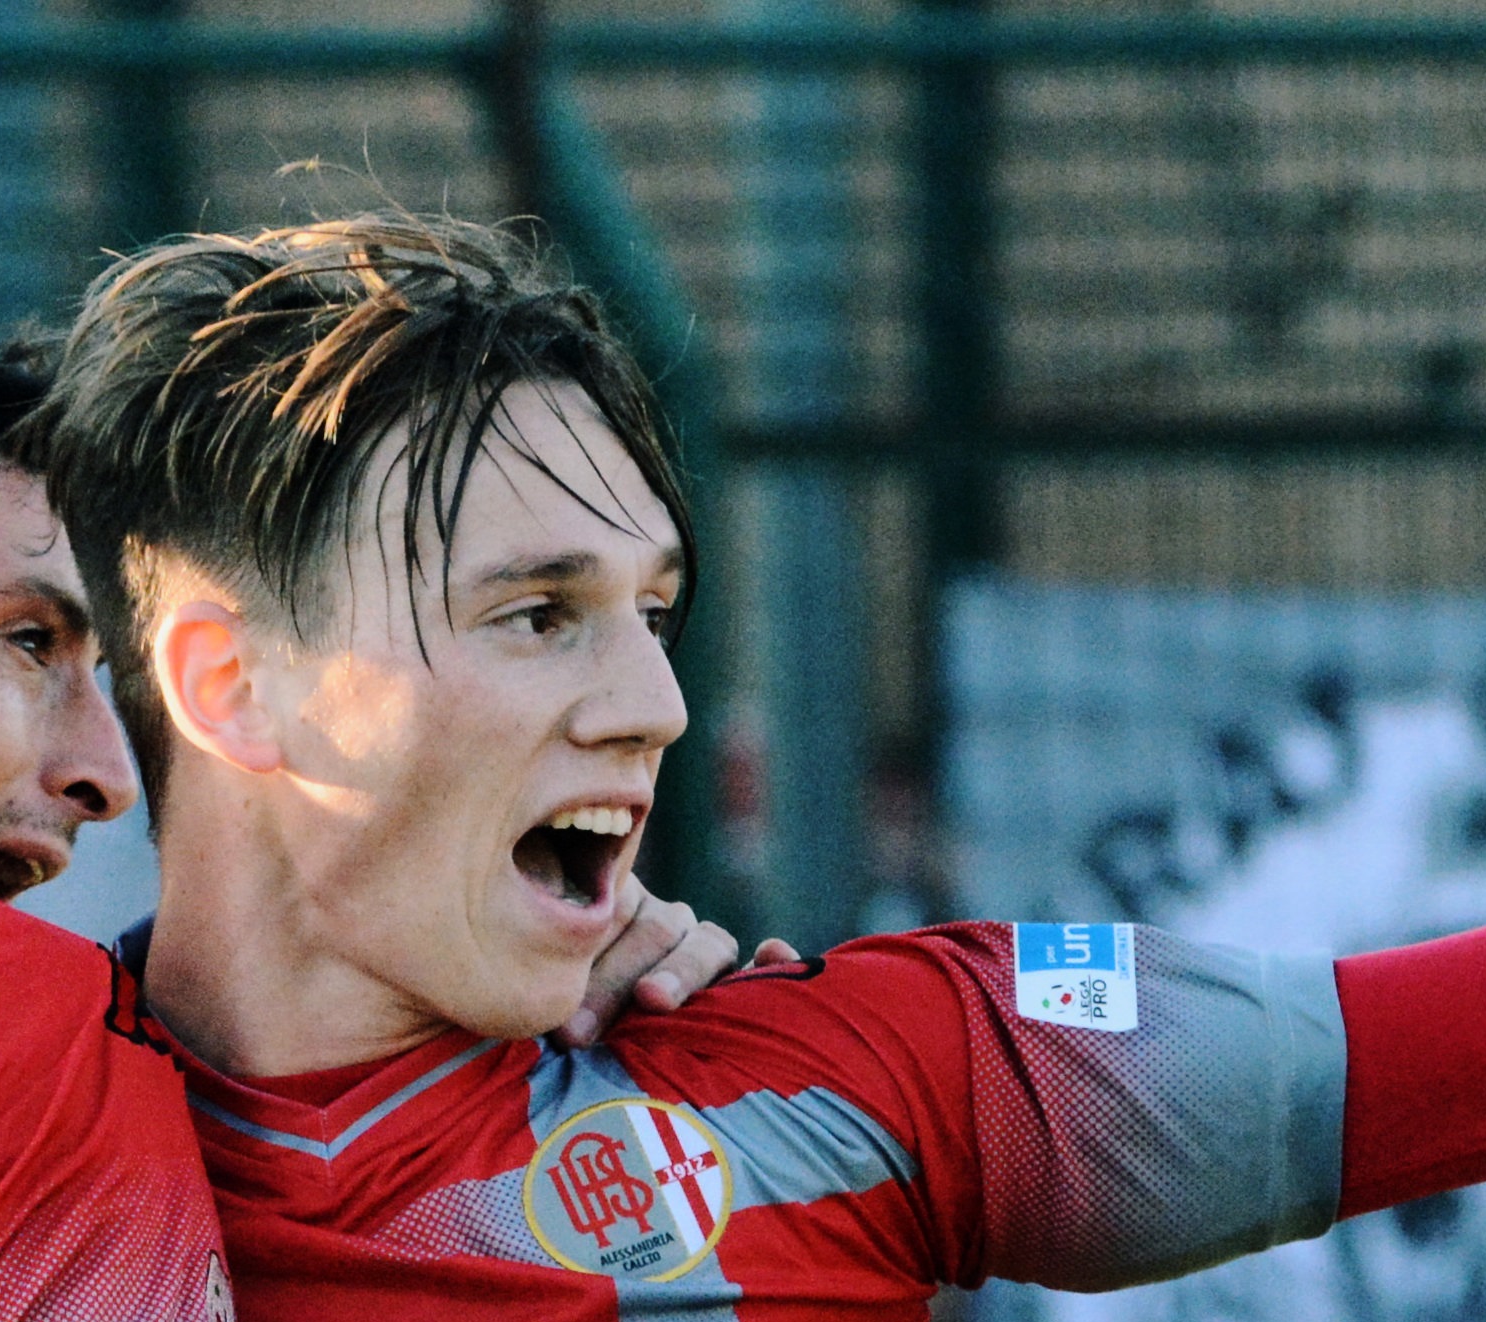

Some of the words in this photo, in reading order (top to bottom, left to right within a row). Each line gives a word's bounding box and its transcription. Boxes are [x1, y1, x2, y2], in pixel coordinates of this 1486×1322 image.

[1079, 980, 1091, 1017] LEGA
[1092, 979, 1107, 1018] PRO
[662, 1156, 706, 1182] 1912
[599, 1232, 674, 1267] ALESSANDRIA
[622, 1252, 662, 1272] CALCIO
